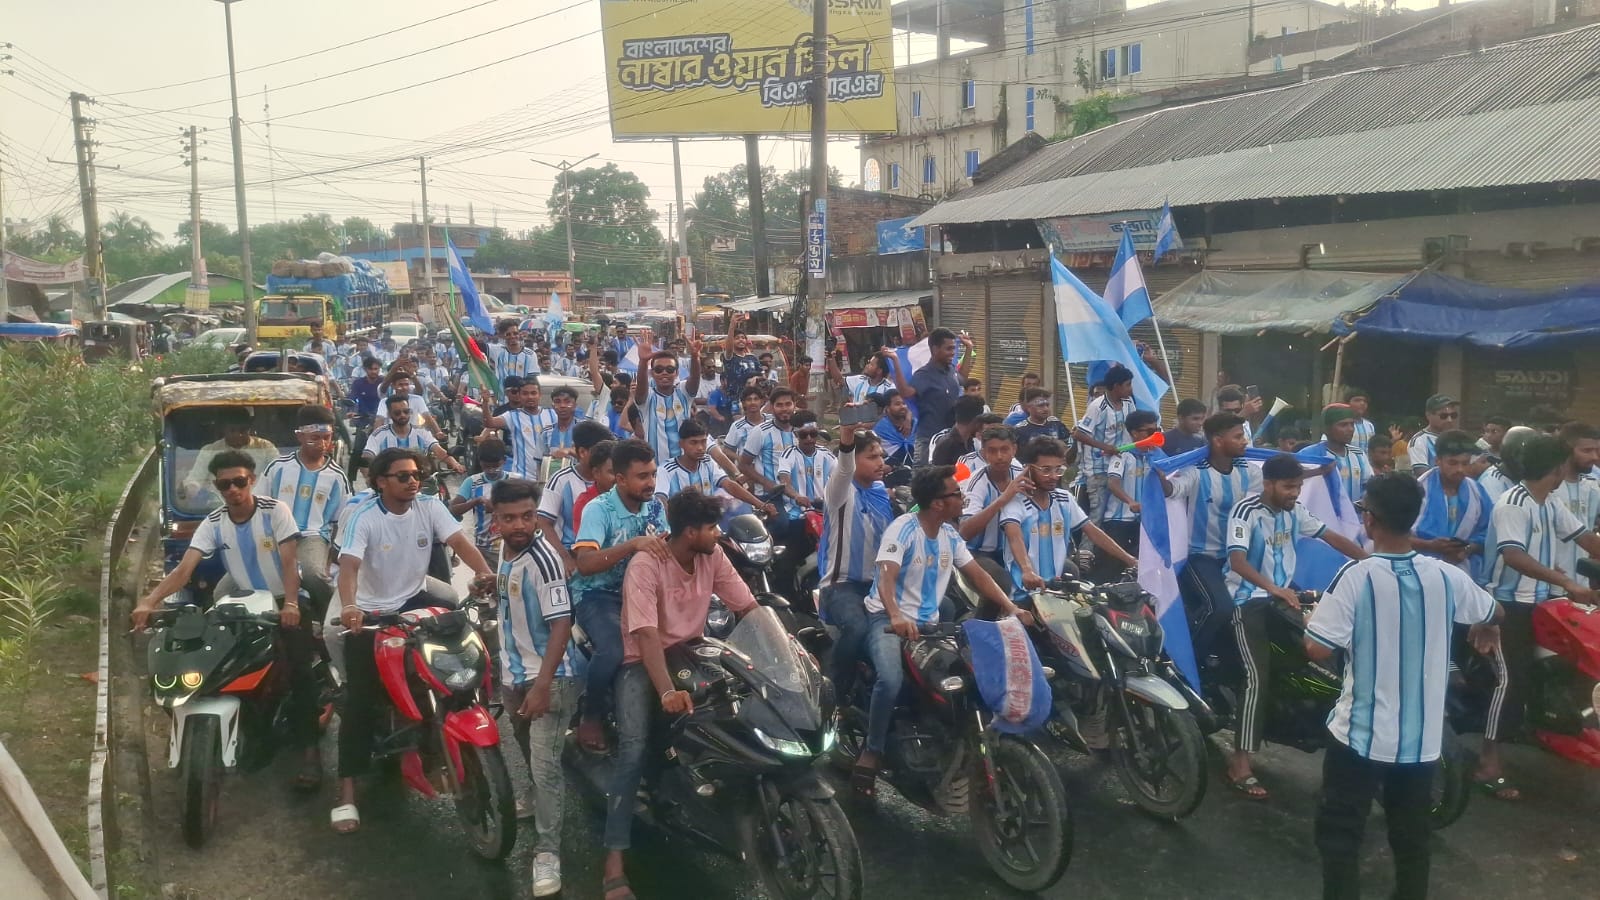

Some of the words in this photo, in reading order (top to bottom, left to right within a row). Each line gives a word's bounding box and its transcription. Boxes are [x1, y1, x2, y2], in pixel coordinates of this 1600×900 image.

[625, 35, 731, 59] বাংলাদেশের
[619, 54, 704, 86] নাম্বার
[1495, 370, 1569, 384] SAUDI
